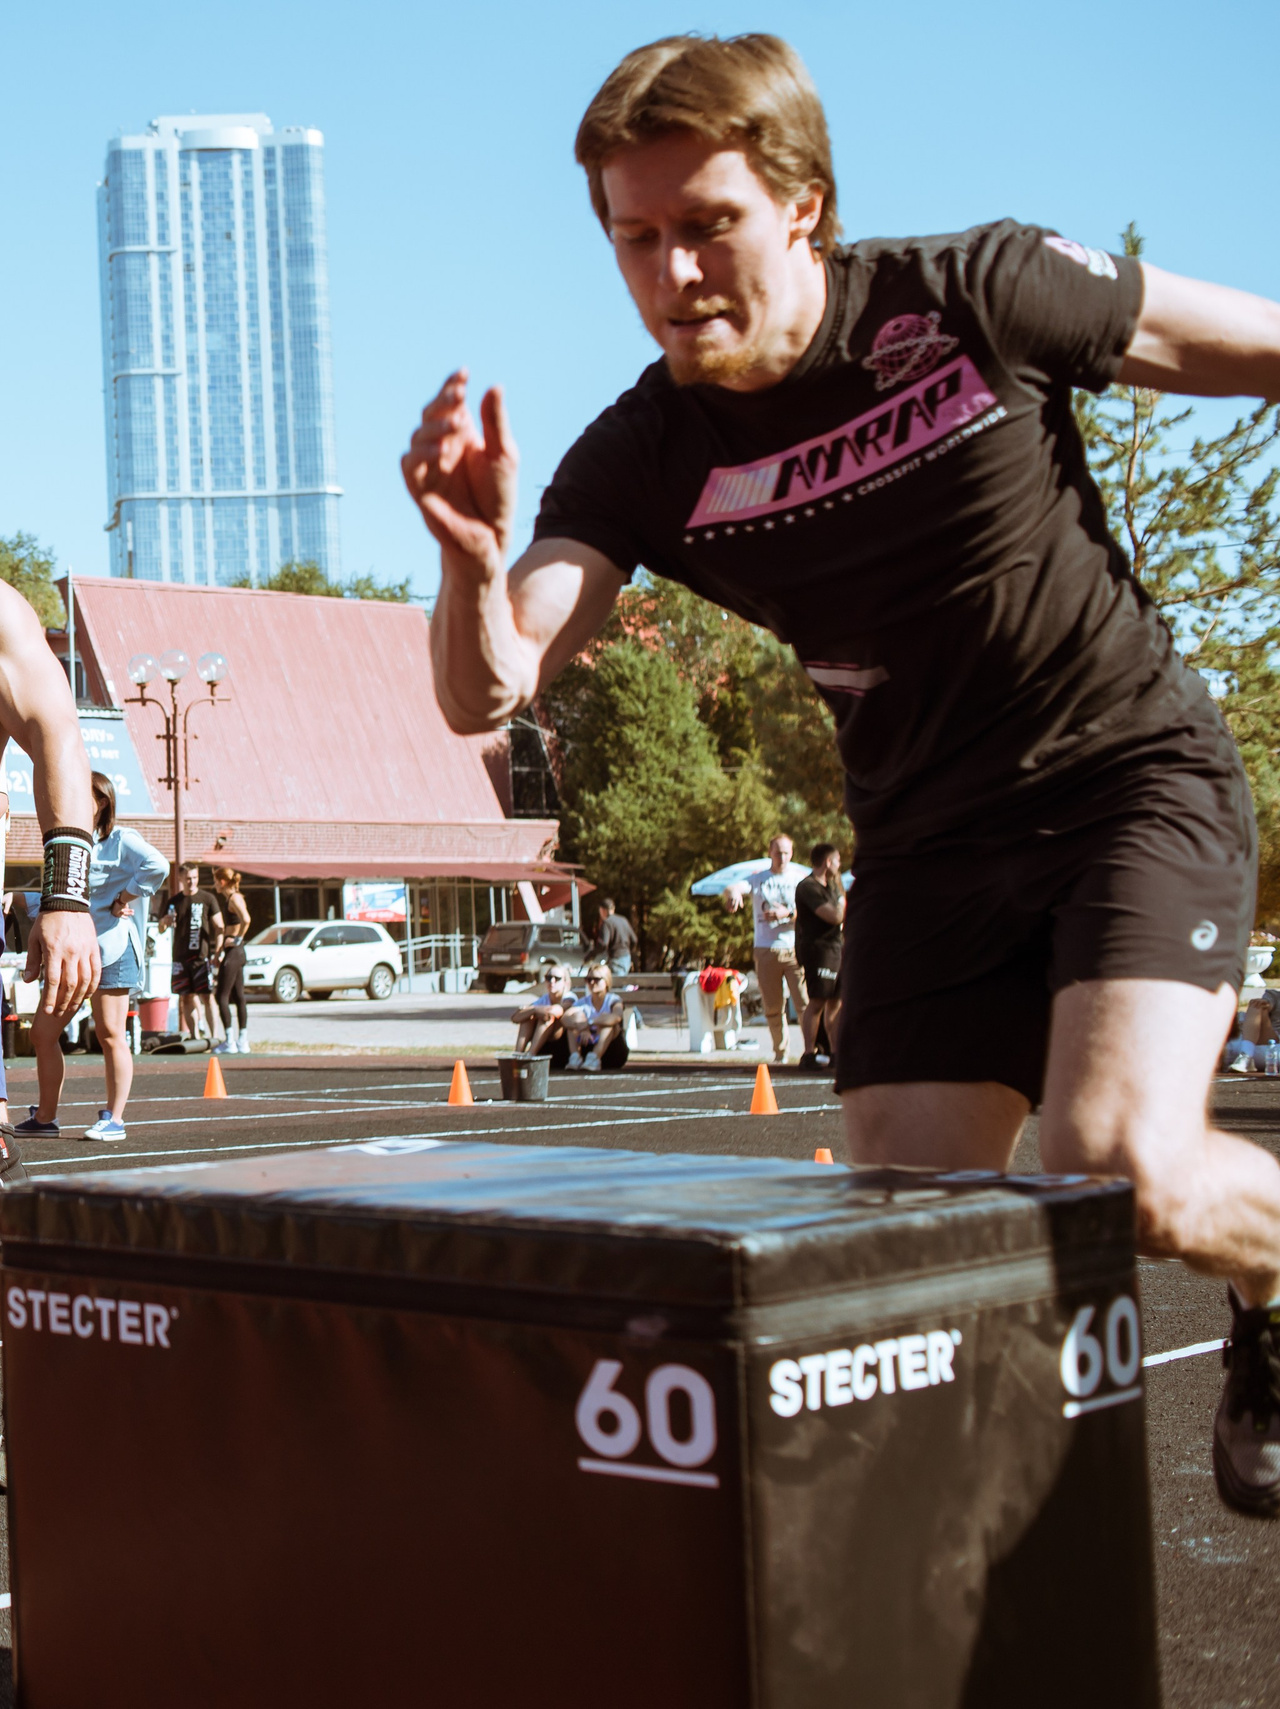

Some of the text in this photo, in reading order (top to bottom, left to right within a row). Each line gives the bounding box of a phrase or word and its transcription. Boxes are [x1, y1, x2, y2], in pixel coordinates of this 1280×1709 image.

[771, 367, 963, 502] AMRAP
[857, 405, 1008, 496] CROSSFIT WORLDWIDE
[8, 1286, 172, 1349] STECTER
[1060, 1295, 1140, 1399] 60
[575, 1359, 717, 1469] 60
[768, 1330, 957, 1418] STECTER
